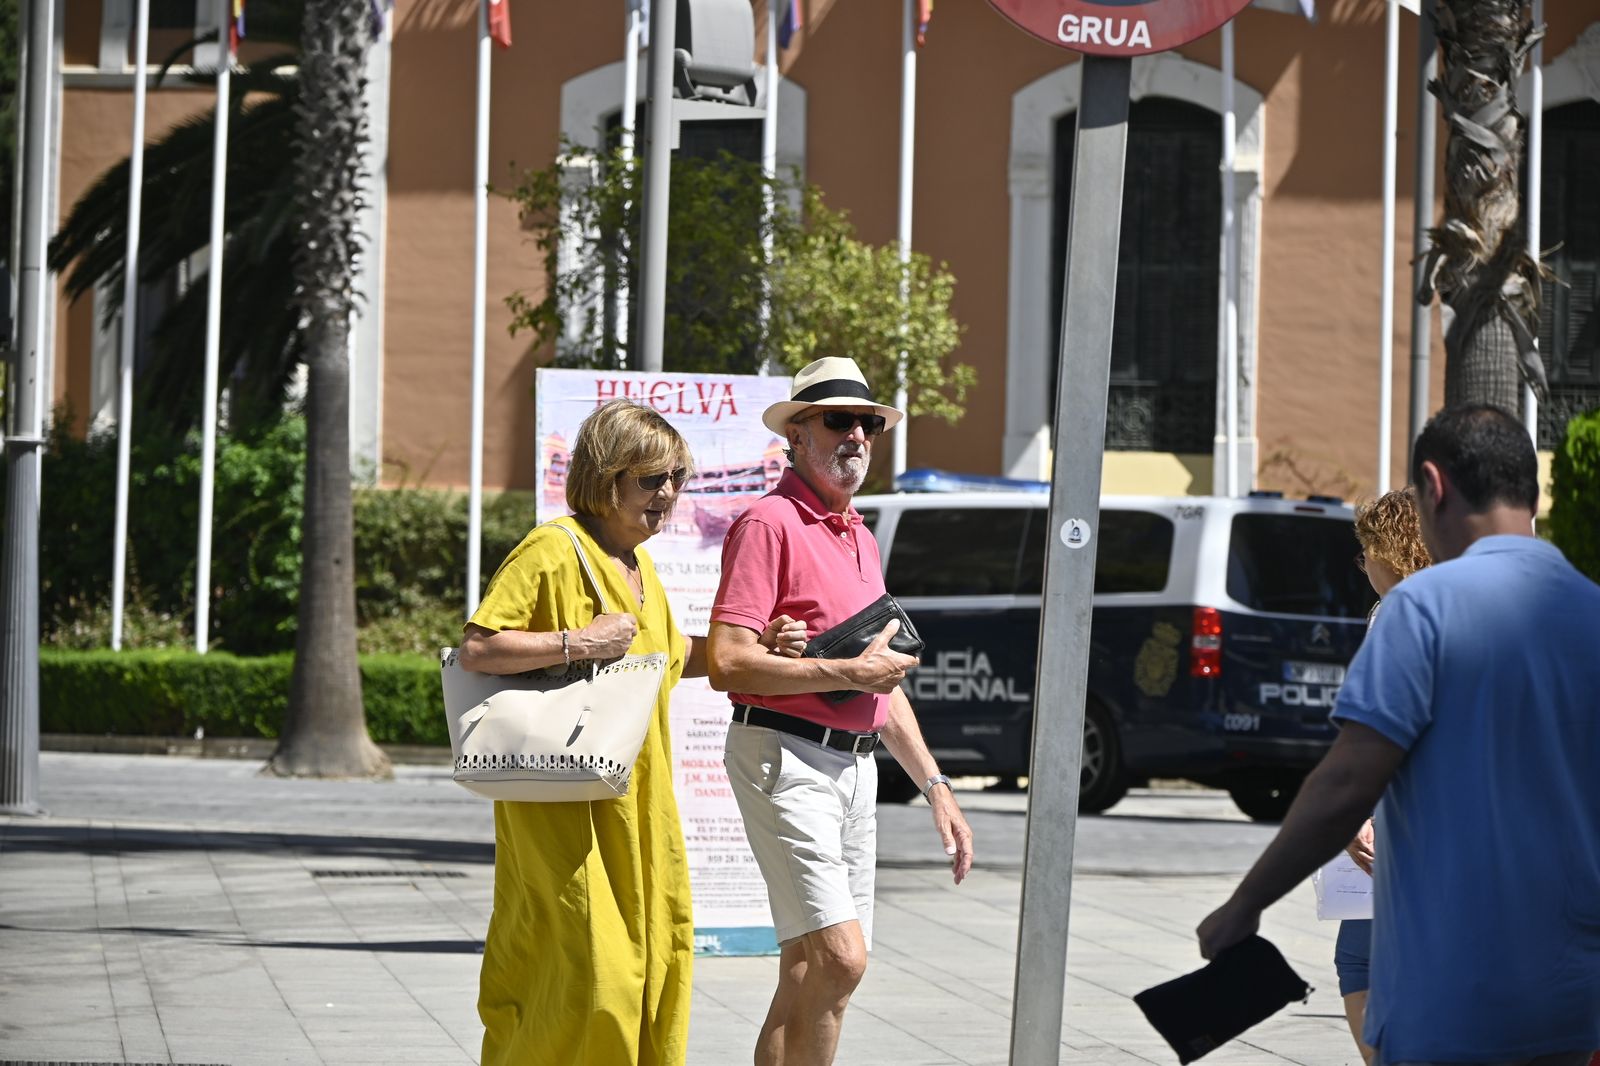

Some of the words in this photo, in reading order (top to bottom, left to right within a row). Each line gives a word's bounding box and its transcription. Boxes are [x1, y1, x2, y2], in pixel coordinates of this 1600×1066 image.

[1057, 13, 1152, 49] GRUA
[595, 379, 738, 423] HUELVA
[906, 646, 993, 676] LICÍA
